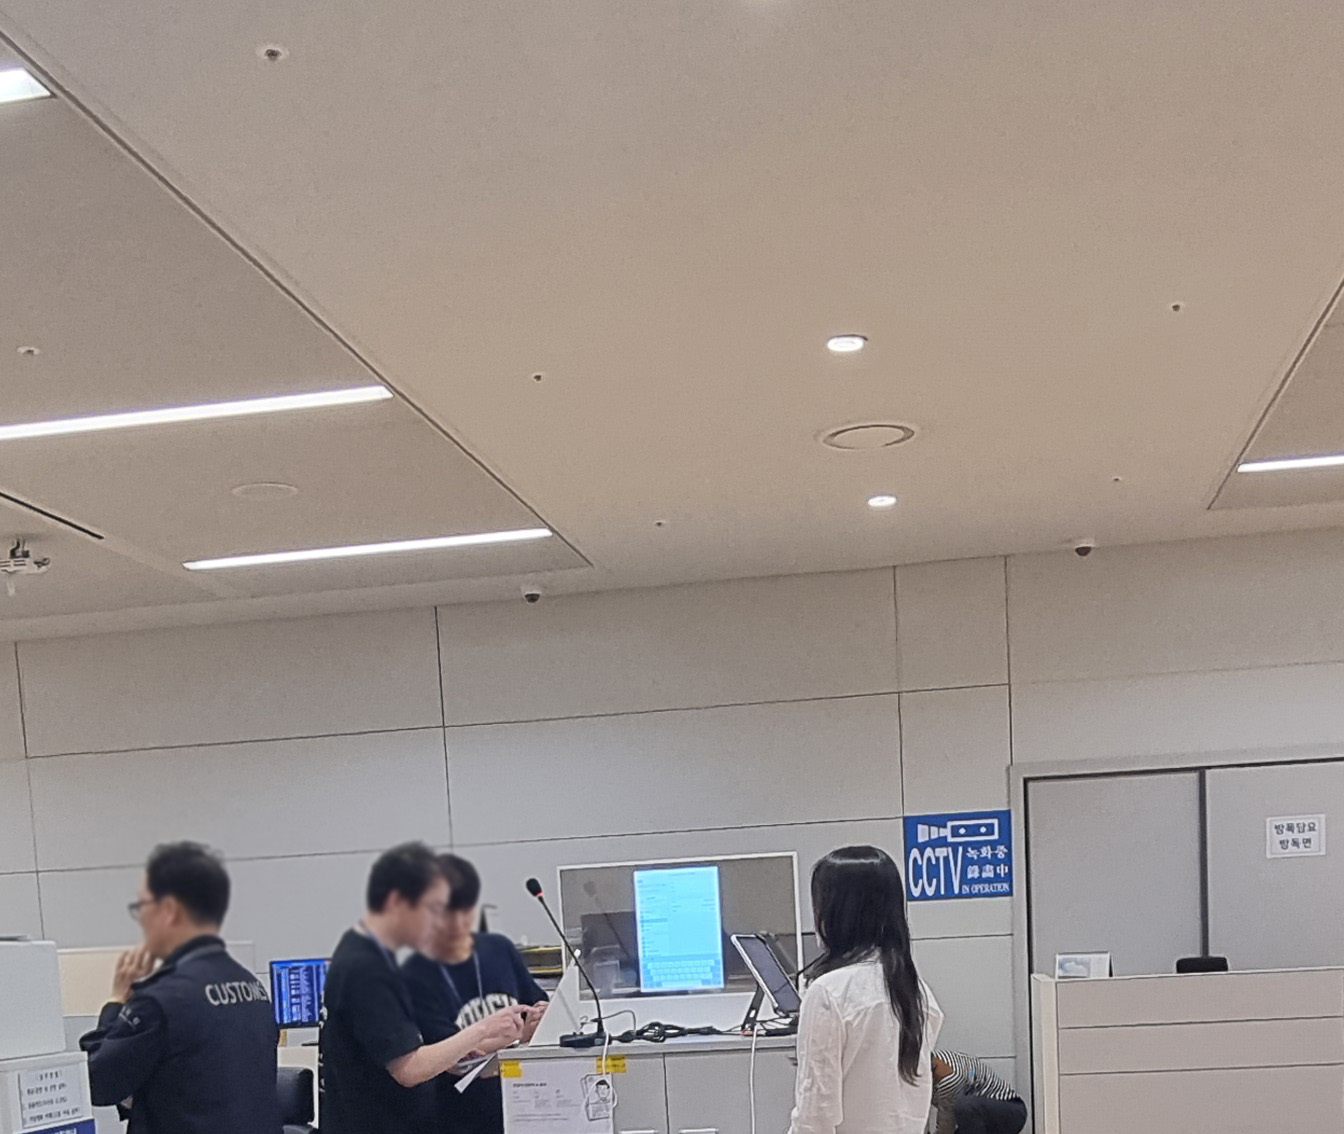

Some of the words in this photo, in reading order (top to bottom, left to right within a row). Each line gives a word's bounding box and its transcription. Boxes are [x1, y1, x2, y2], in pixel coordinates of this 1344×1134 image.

[966, 845, 1008, 860] 녹화중
[908, 846, 963, 897] CCTV
[961, 885, 970, 894] IN
[971, 883, 1010, 894] OPERATION
